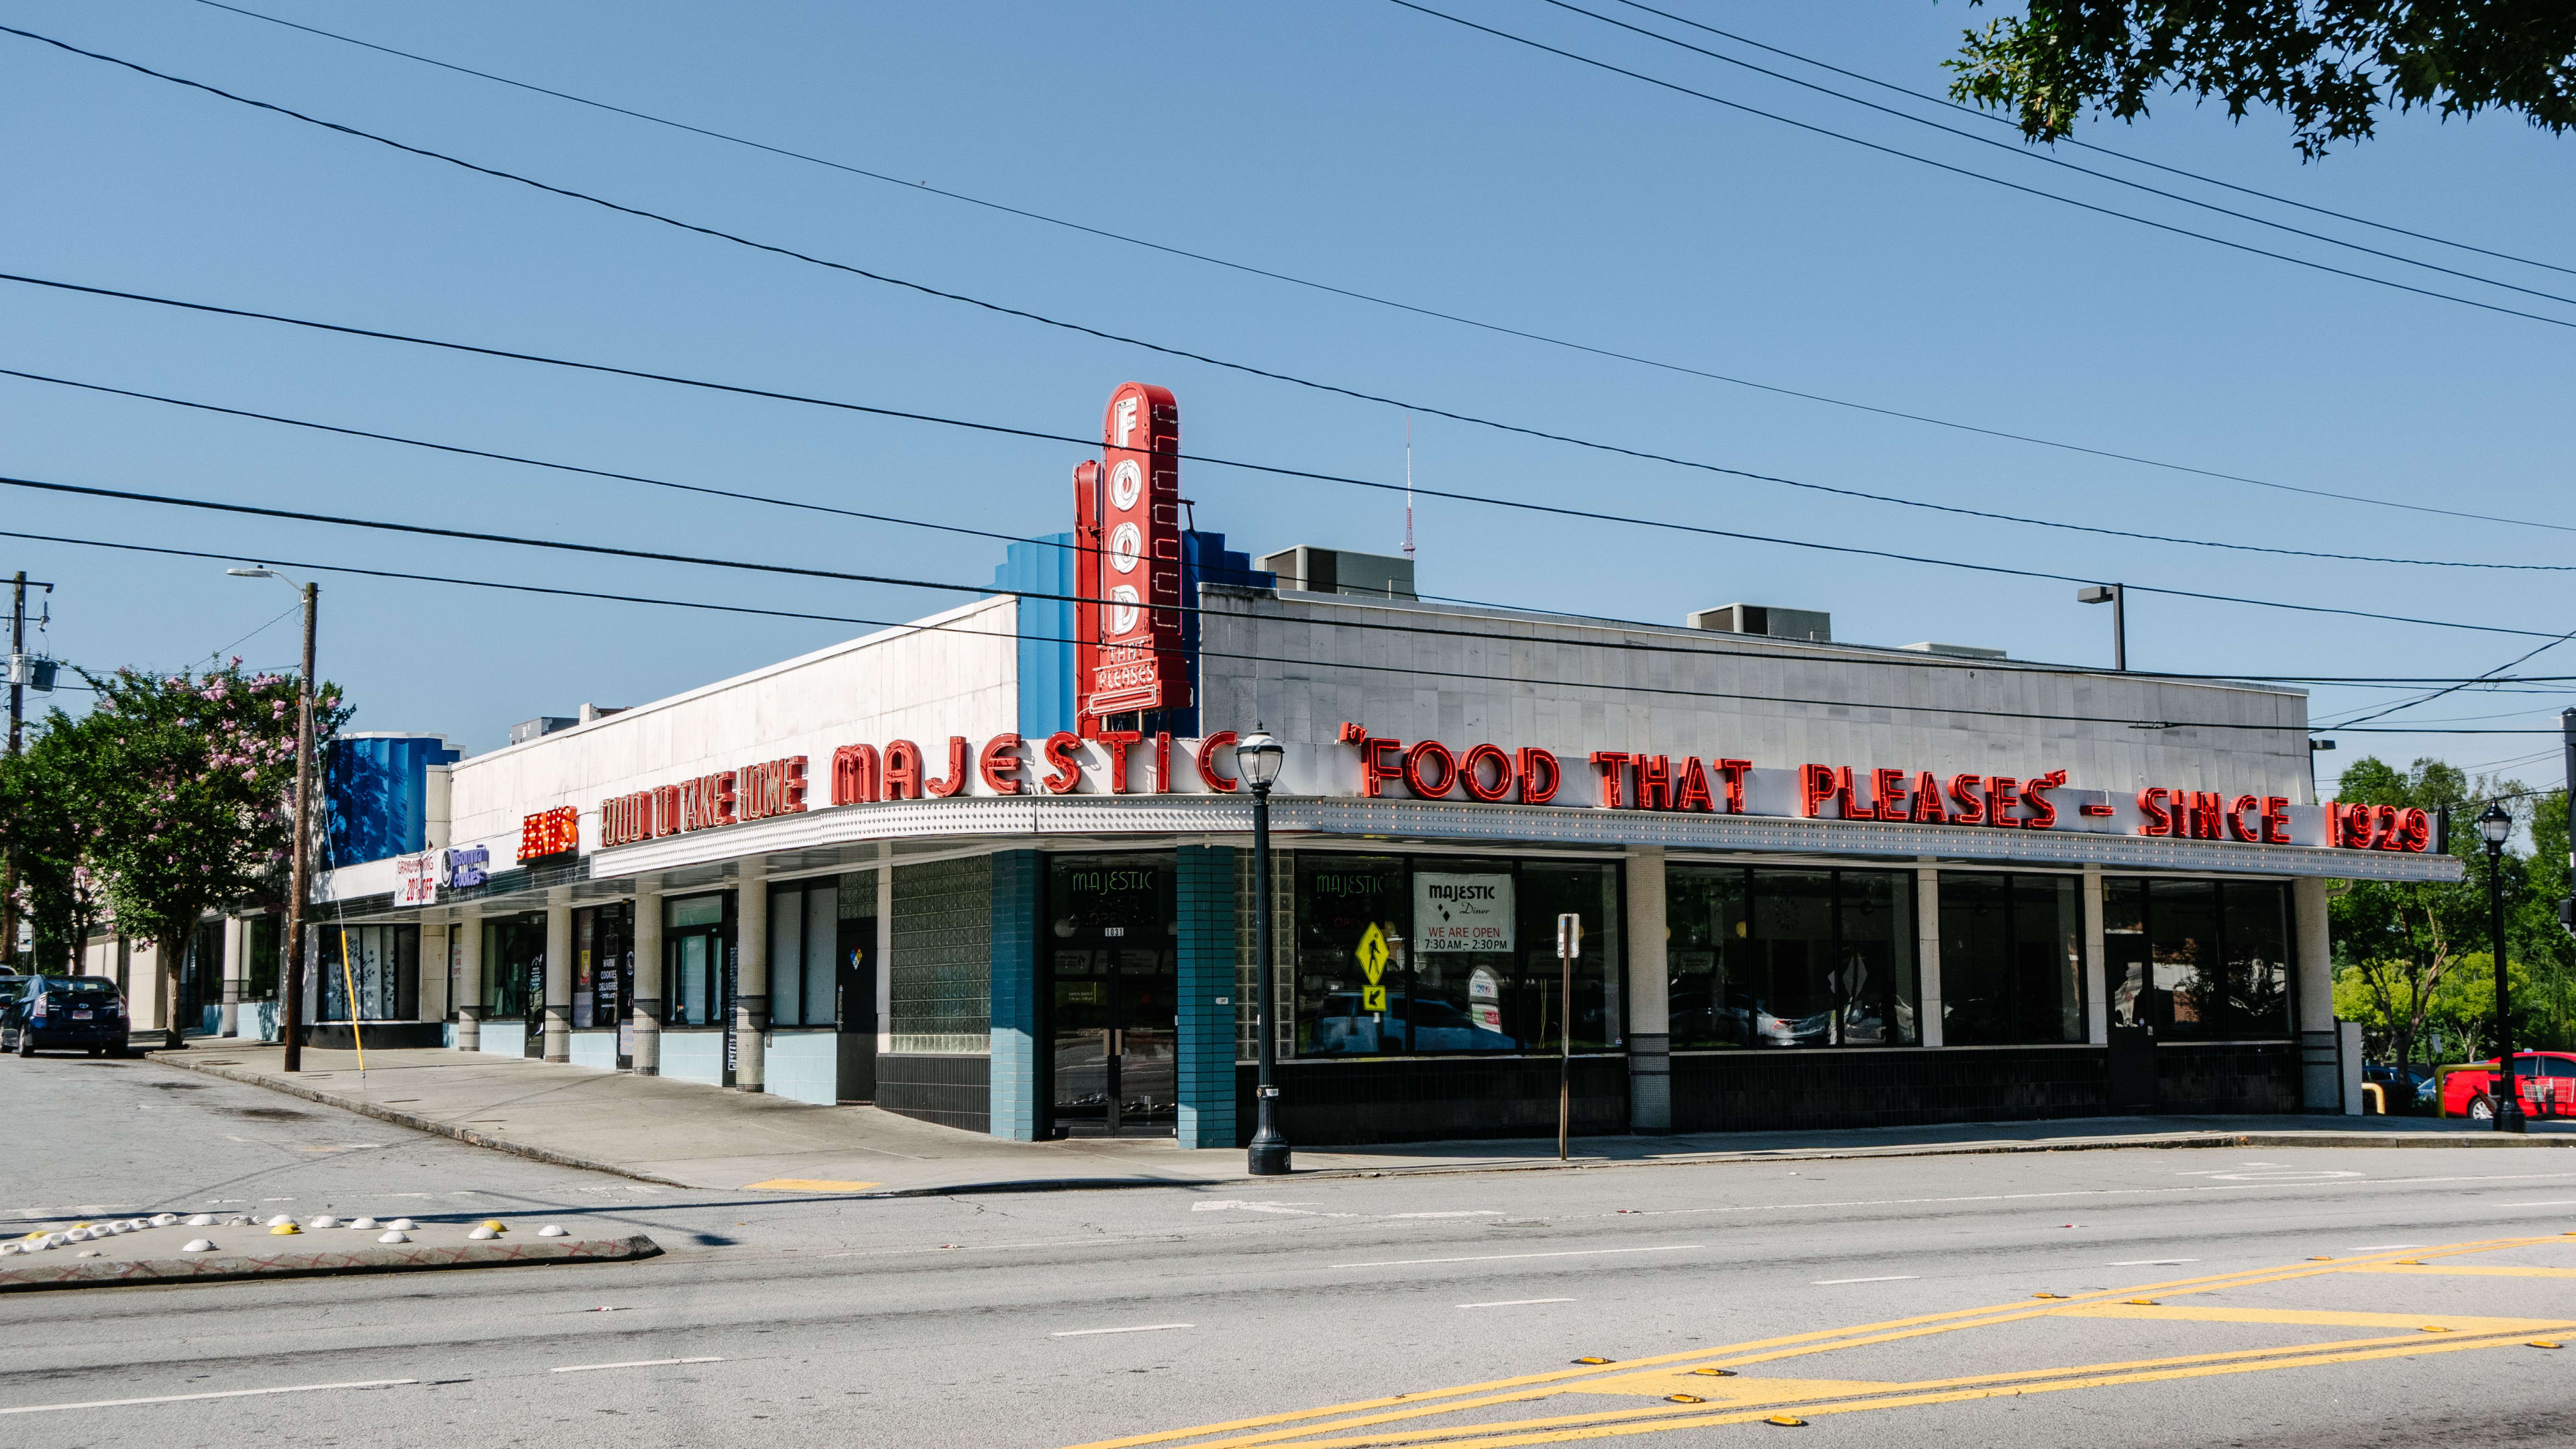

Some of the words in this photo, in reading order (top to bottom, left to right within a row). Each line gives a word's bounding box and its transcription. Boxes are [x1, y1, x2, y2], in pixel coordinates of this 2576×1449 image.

[1109, 396, 1142, 636] FOOD
[1108, 639, 1144, 662] THAT
[1097, 664, 1155, 690] PLEASES
[830, 730, 1238, 806] MAJESTIC
[598, 792, 653, 847] FOOD
[650, 784, 682, 837] TO
[678, 771, 737, 831] TAKE
[737, 755, 808, 822] HOME
[1590, 751, 1752, 814] THAT
[2137, 787, 2292, 845] SINCE
[2326, 802, 2430, 853] 1929
[413, 856, 433, 873] OPNING
[422, 877, 433, 900] OFF
[1073, 871, 1152, 895] MAJESTIC
[1317, 875, 1383, 898] MAJESTIC
[1429, 885, 1495, 902] MAJESTIC
[1460, 902, 1490, 914] Diner
[1106, 928, 1123, 936] 1031
[1428, 927, 1444, 937] WE
[1448, 927, 1469, 938] ARE
[1472, 927, 1500, 938] OPEN
[1425, 939, 1446, 949] 7:30
[1447, 940, 1462, 949] AM
[1472, 939, 1493, 949] 2:30
[1494, 940, 1507, 949] PM
[602, 958, 615, 967] WARM
[600, 970, 617, 979] COOKIES
